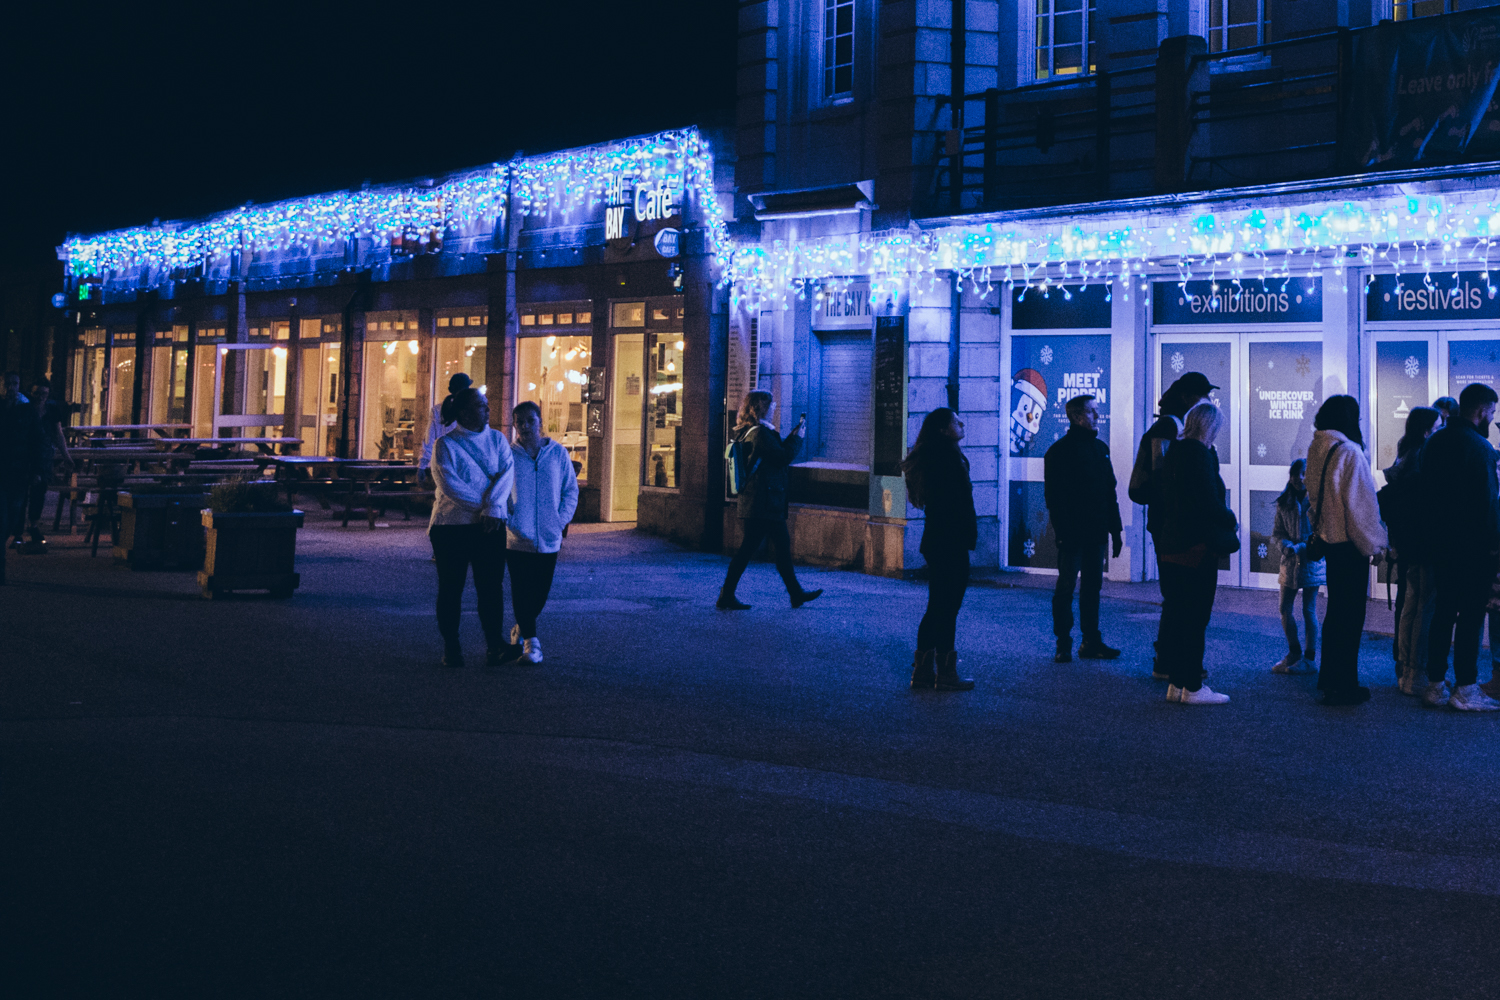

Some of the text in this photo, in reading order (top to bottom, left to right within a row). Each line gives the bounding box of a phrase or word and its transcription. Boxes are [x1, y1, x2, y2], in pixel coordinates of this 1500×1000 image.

[1398, 75, 1441, 94] Leave
[1447, 63, 1480, 95] only
[605, 206, 625, 240] BAY
[1190, 287, 1290, 314] exhibitions
[1397, 280, 1482, 311] festivals
[1063, 372, 1101, 388] MEET
[1259, 390, 1314, 401] UNDERCOVER
[1270, 400, 1304, 411] WINTER
[1269, 409, 1304, 420] ICE RINK
